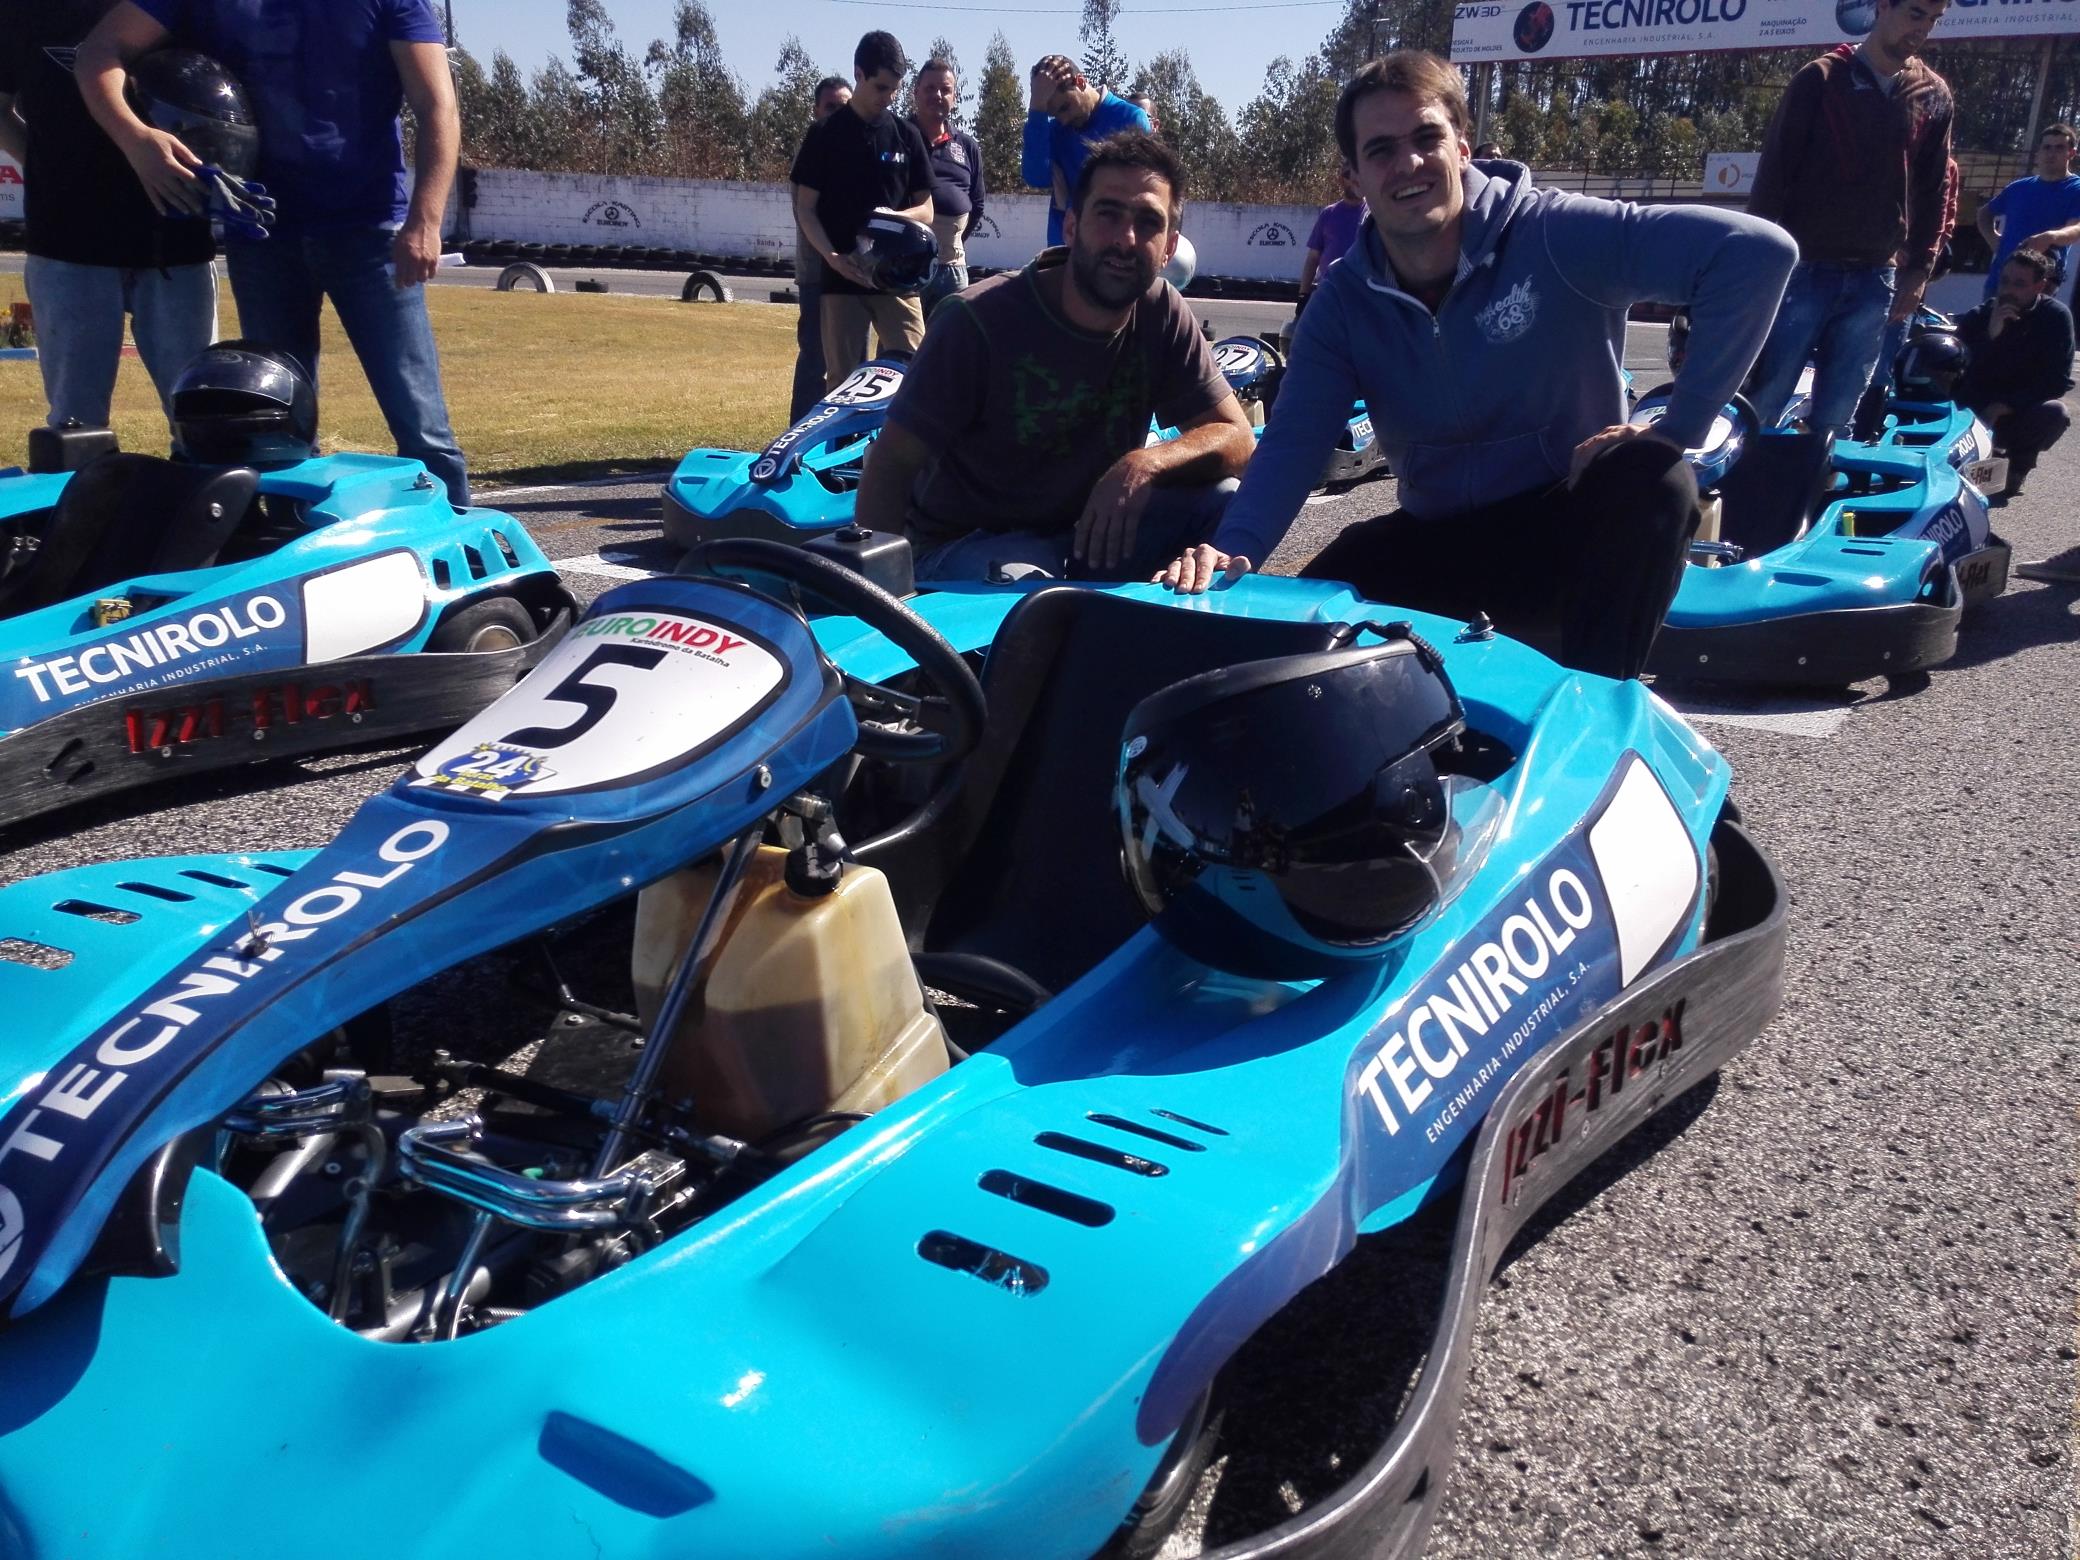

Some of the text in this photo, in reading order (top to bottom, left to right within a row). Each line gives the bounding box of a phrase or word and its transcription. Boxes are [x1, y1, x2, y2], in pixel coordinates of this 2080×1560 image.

[1566, 0, 1747, 31] TECNIROLO
[1935, 16, 2000, 27] NGENHARIA
[1584, 36, 1637, 46] ENGENHARIA
[1498, 304, 1525, 330] 68
[1215, 347, 1250, 367] 27
[836, 371, 893, 398] 25
[15, 595, 286, 703] TECNIROLO
[571, 617, 747, 655] EUROINDY
[694, 650, 730, 668] Batalha
[497, 643, 669, 750] 5
[450, 751, 531, 779] 24
[0, 819, 450, 1162] TECNIROLO
[1357, 867, 1593, 1136] TECNIROLO
[1425, 961, 1591, 1144] ENGENHARIA INDUSTRIAL, S.A.
